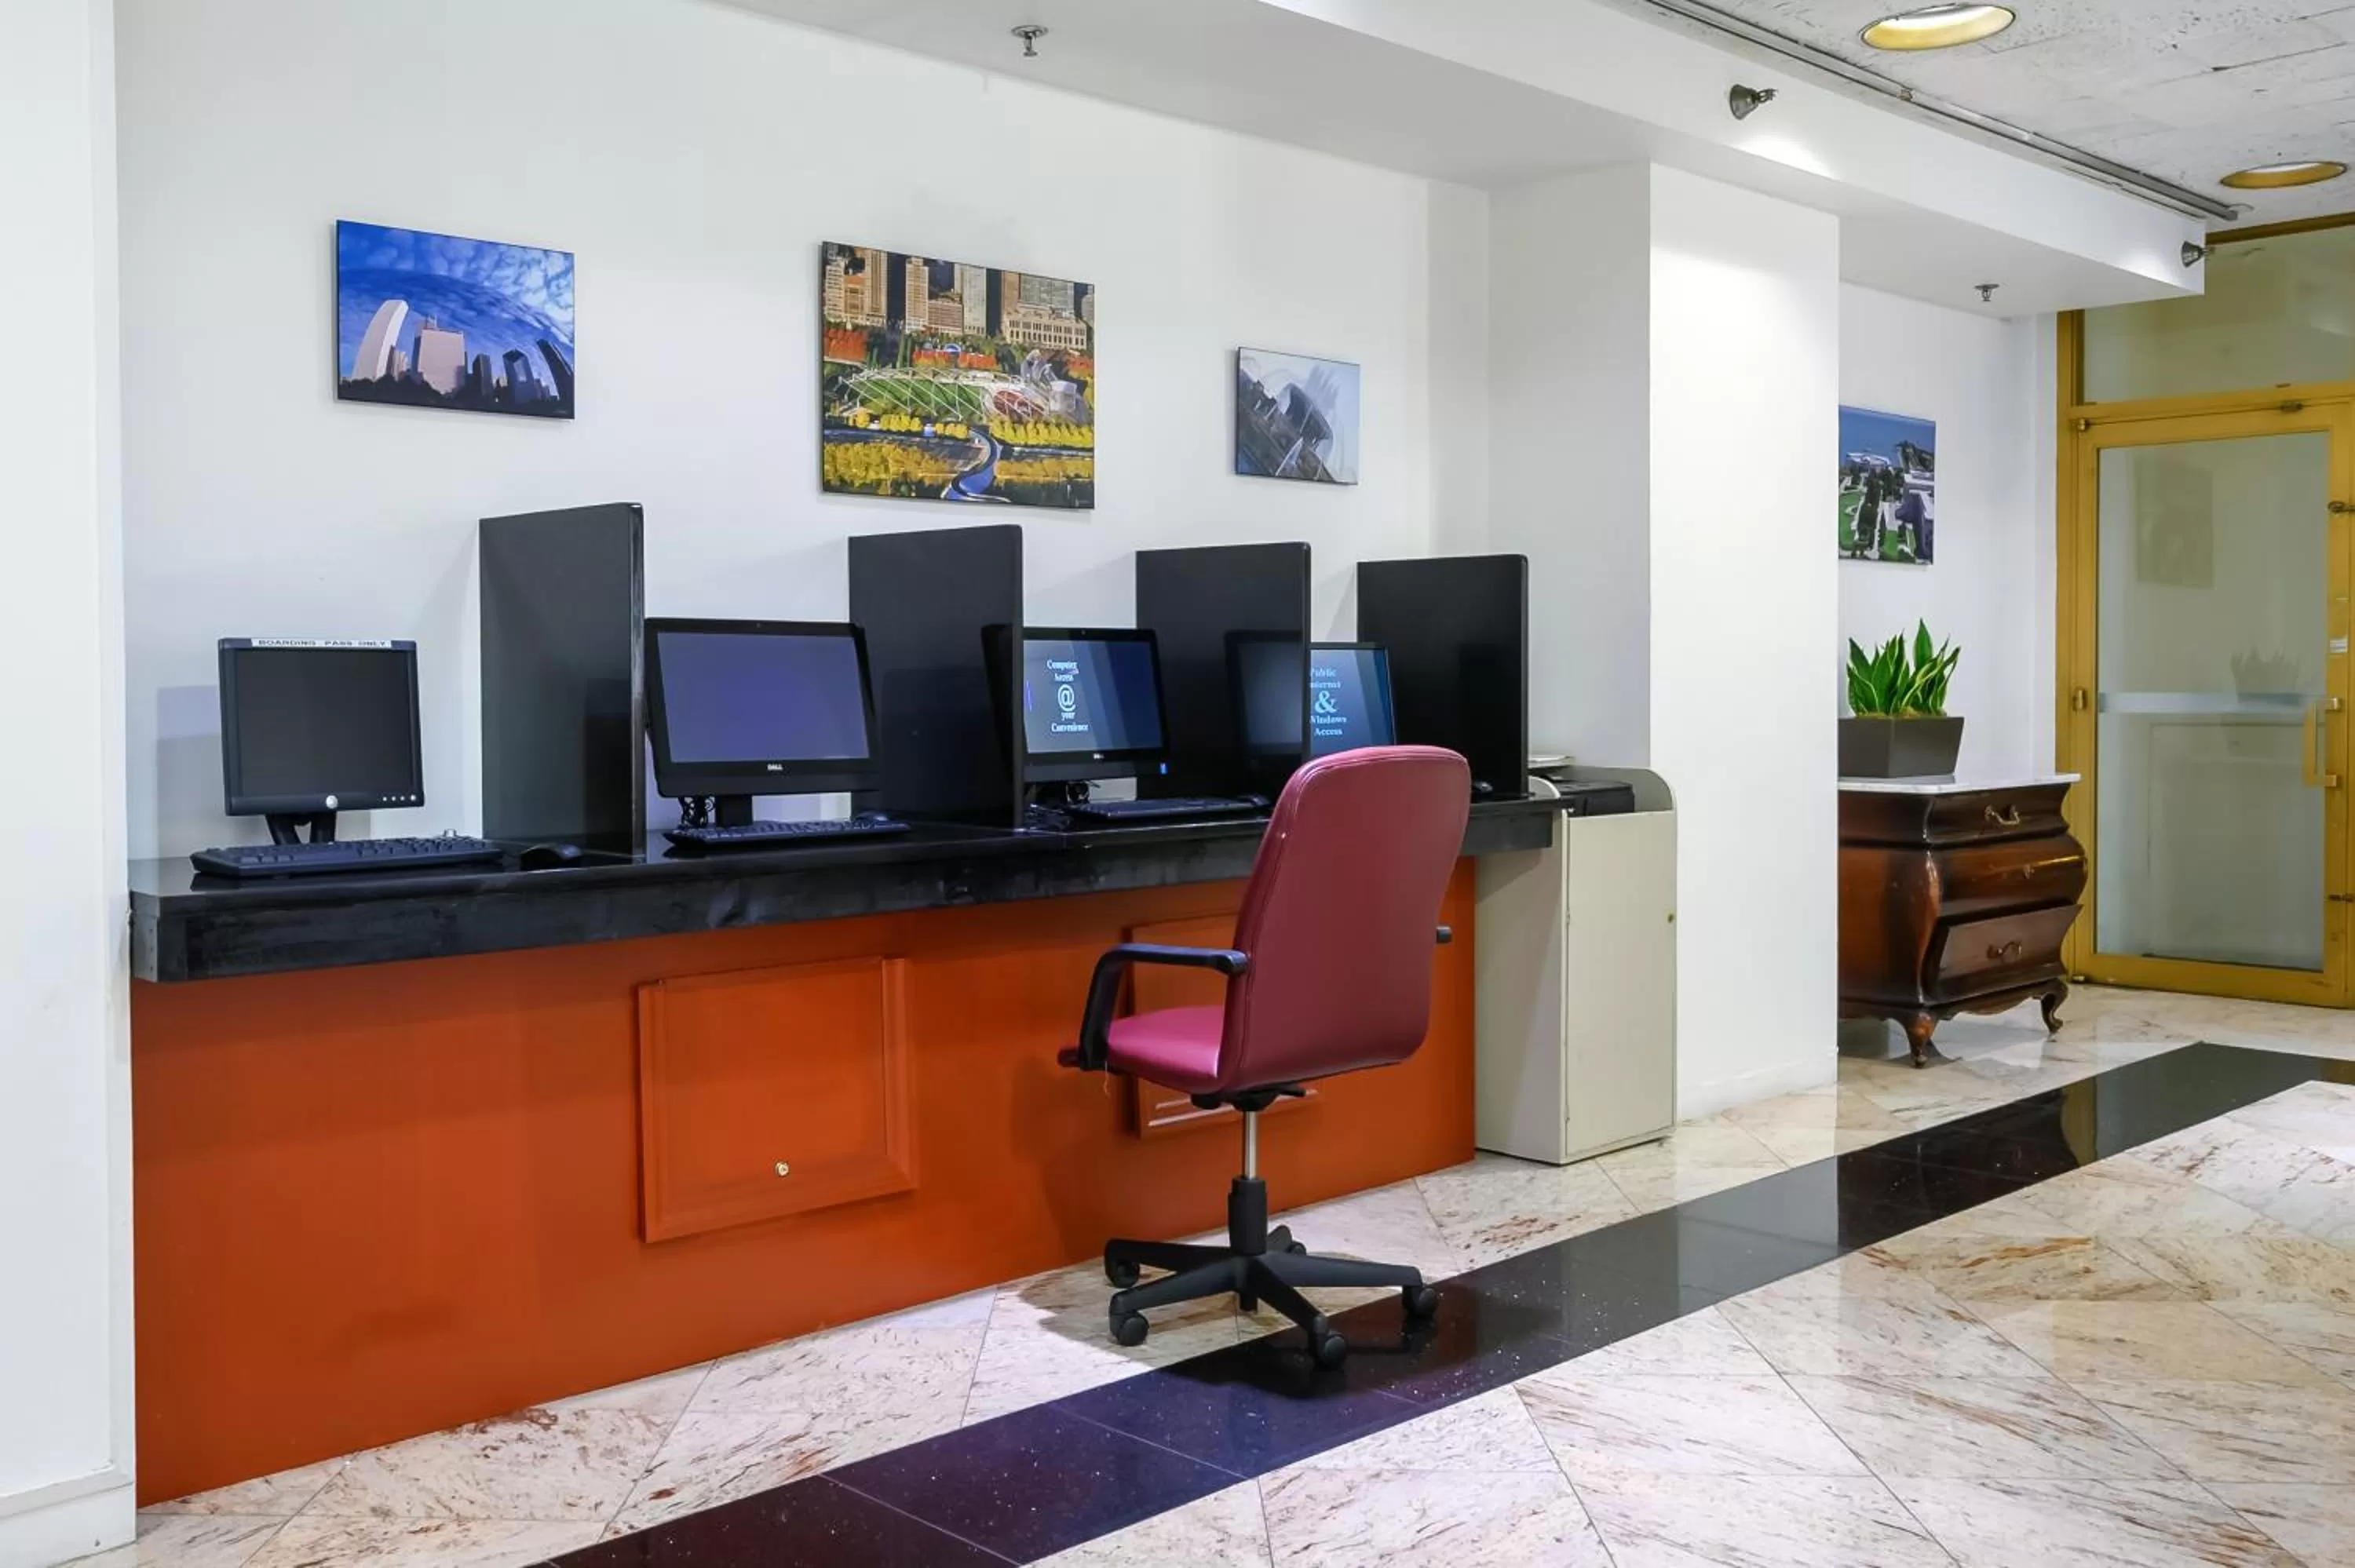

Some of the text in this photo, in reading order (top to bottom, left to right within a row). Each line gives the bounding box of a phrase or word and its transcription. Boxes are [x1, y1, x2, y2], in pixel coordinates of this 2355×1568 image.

[1046, 658, 1078, 671] Computer
[1057, 684, 1075, 712] @
[1314, 690, 1337, 713] &
